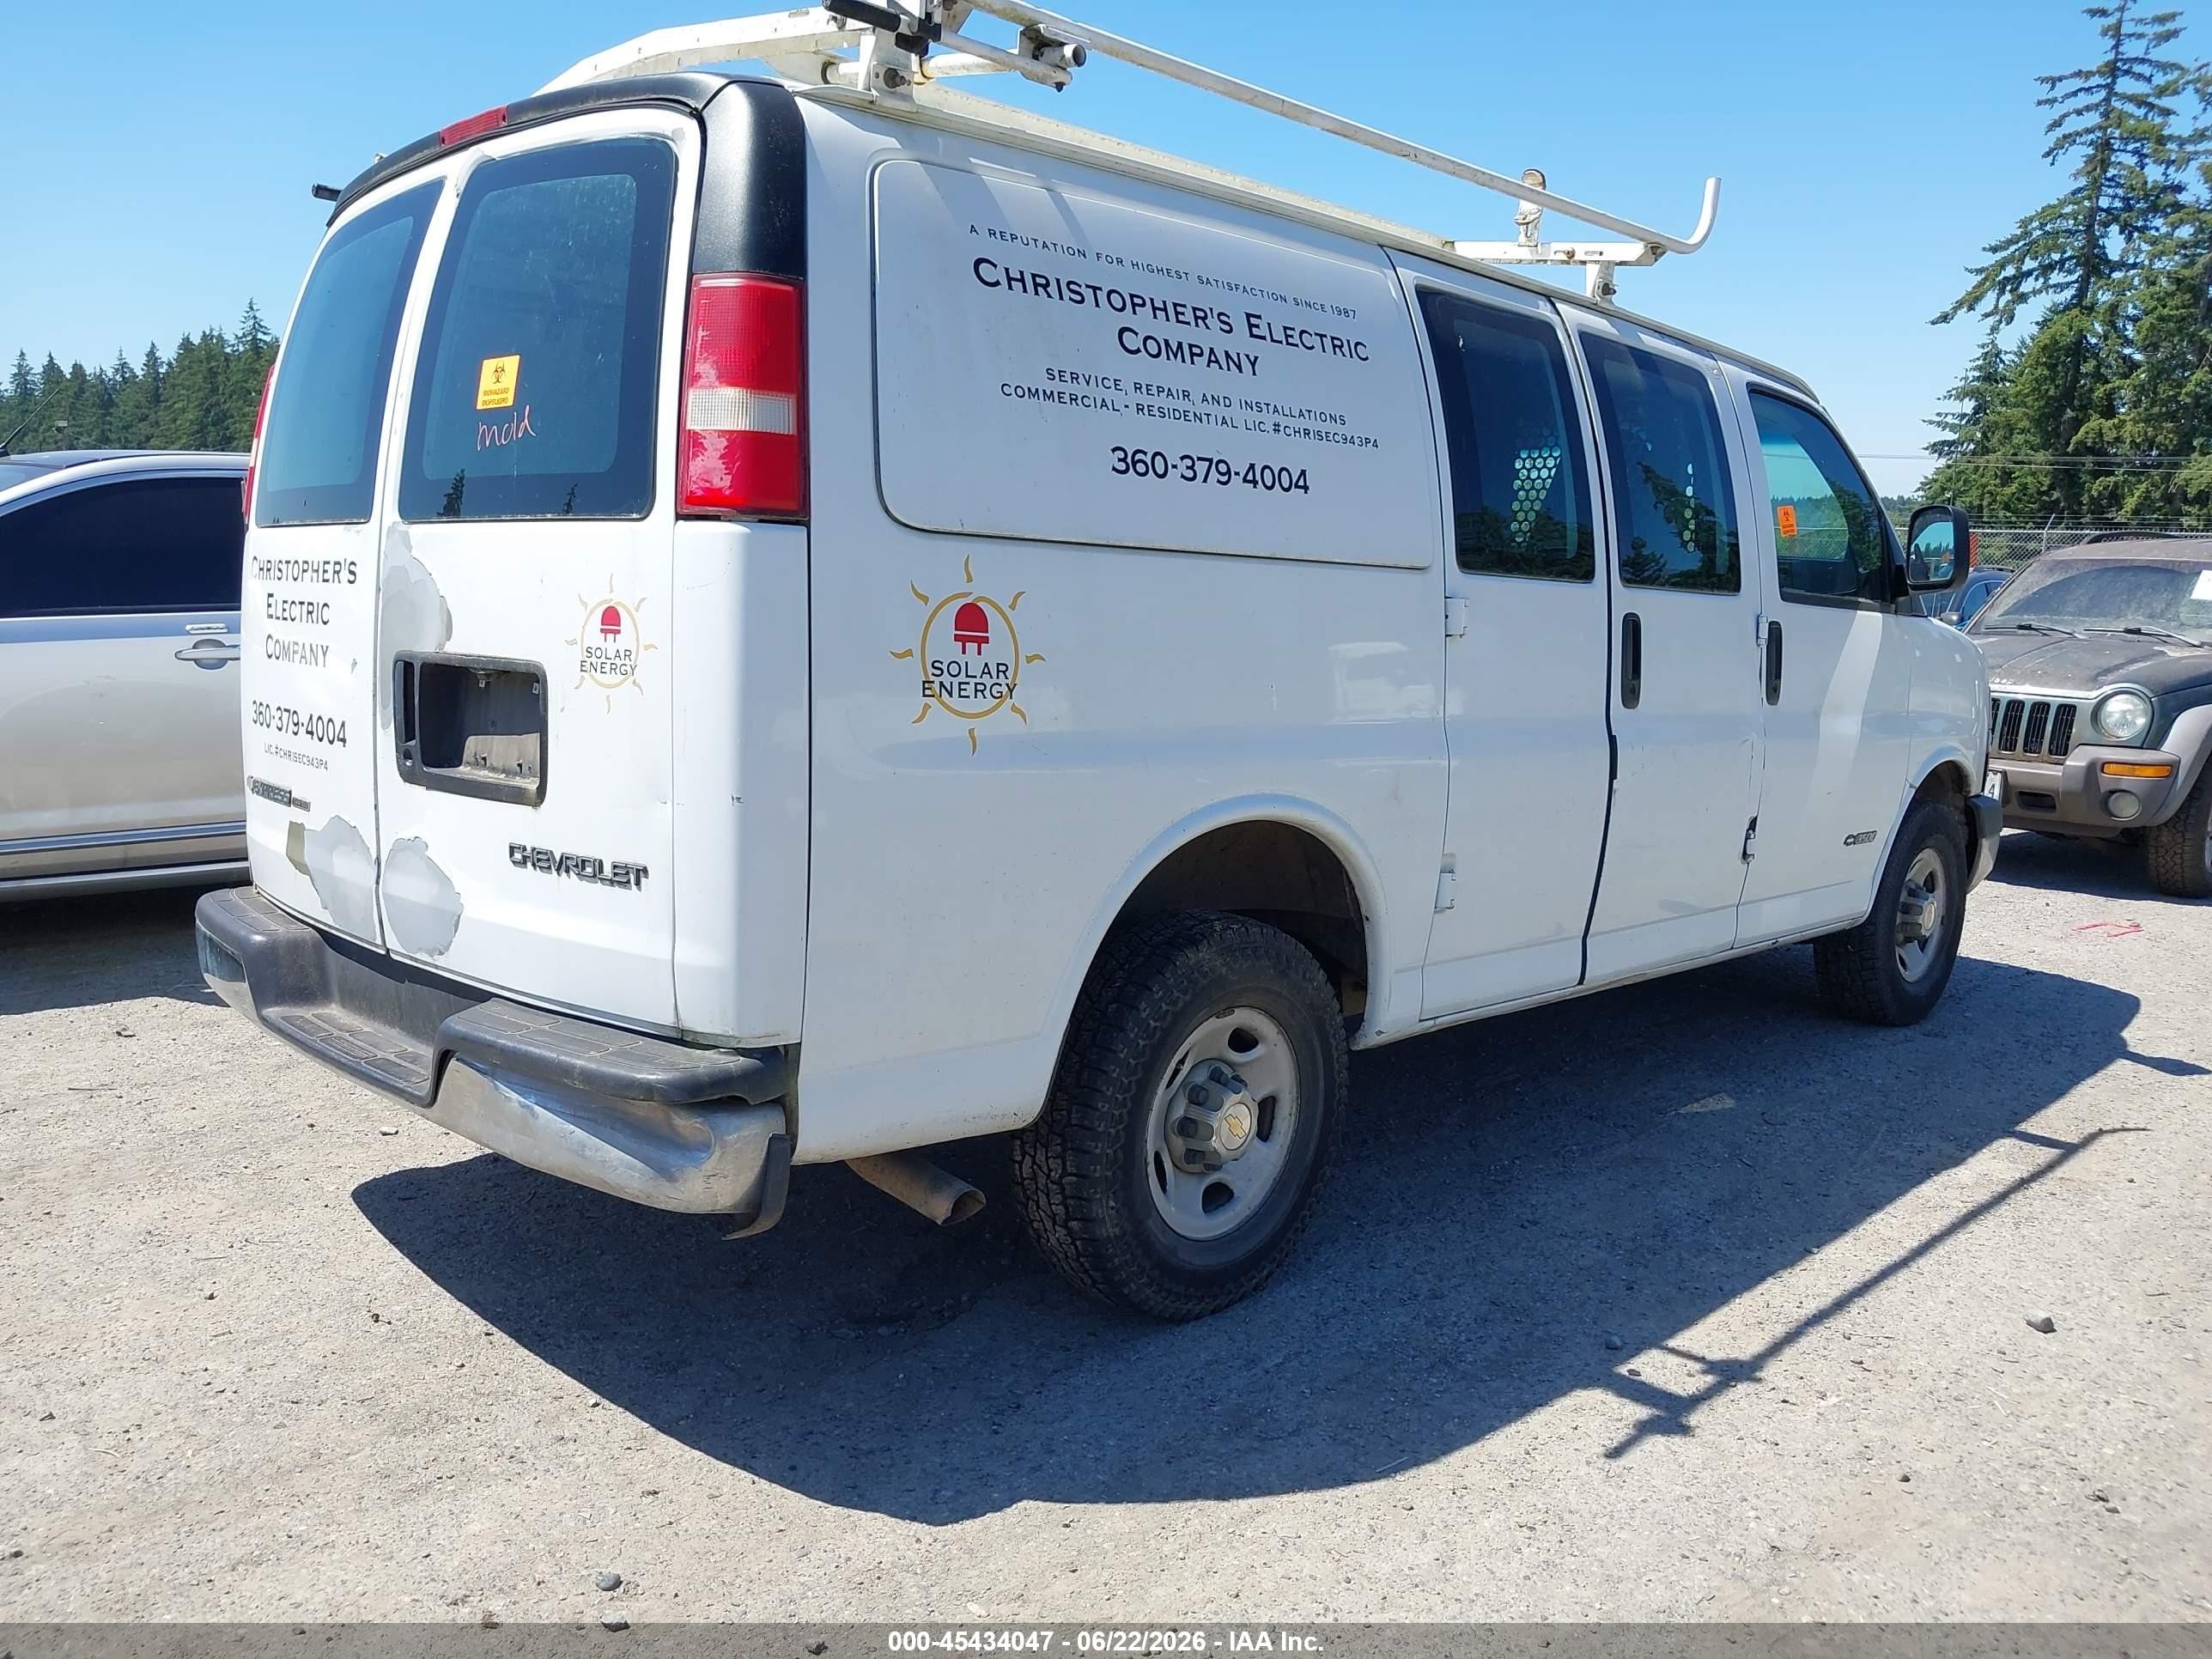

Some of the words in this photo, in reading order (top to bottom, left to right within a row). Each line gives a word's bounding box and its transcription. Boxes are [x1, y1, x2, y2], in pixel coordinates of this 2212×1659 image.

[969, 224, 979, 235] A
[988, 228, 1087, 259] REPUTATION
[1096, 252, 1125, 267] FOR
[1131, 259, 1189, 282] HIGHEST
[1197, 275, 1287, 303] SATISFACTION
[1292, 297, 1328, 313] SINCE
[1330, 304, 1357, 320] 1987
[973, 257, 1234, 335] CHRISTOPHER'S
[1244, 311, 1370, 362] ELECTRIC
[1117, 326, 1260, 376] COMPANY
[1045, 368, 1127, 395] SERVICE,
[1133, 381, 1195, 406] REPAIR,
[1200, 392, 1232, 408] AND
[1238, 398, 1346, 426] INSTALLATIONS
[1135, 403, 1238, 429] RESIDENTIAL
[477, 404, 537, 452] mold
[1110, 446, 1310, 494] 360-379-4004
[252, 555, 357, 585] CHRISTOPHER'S
[266, 592, 330, 625] ELECTRIC
[265, 634, 330, 667] COMPANY
[580, 660, 637, 676] ENERGY
[586, 647, 632, 661] SOLAR
[931, 659, 1010, 680] SOLAR
[921, 680, 1018, 700] ENERGY
[252, 700, 347, 747] 360-379-4004
[508, 842, 649, 891] CHEVROLET
